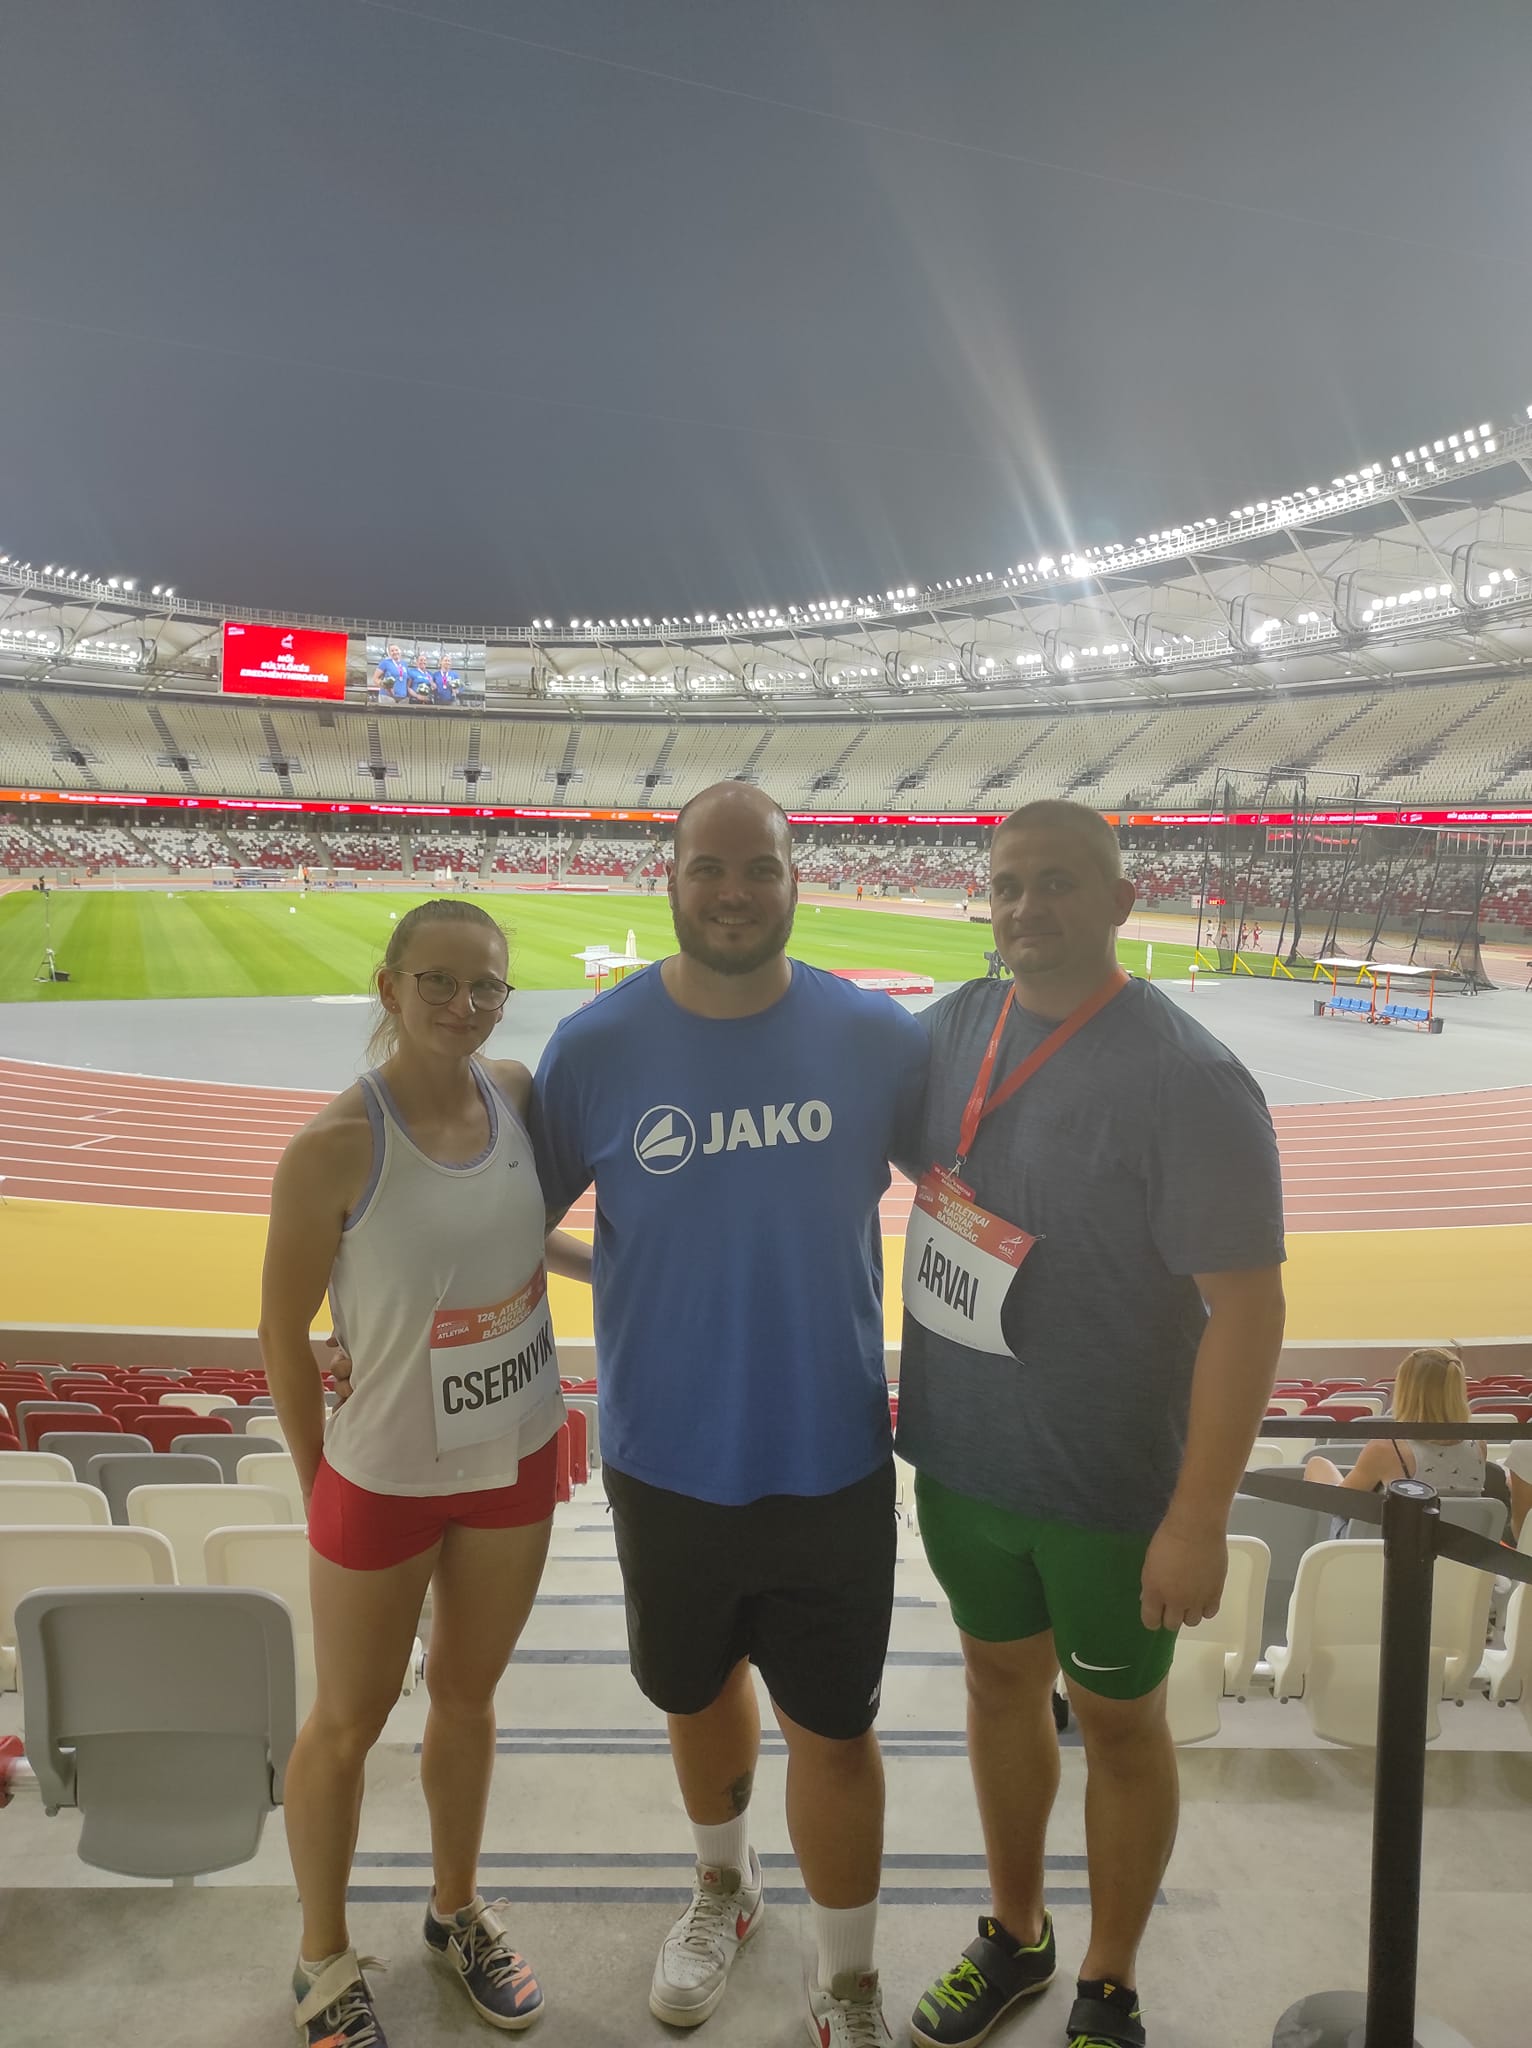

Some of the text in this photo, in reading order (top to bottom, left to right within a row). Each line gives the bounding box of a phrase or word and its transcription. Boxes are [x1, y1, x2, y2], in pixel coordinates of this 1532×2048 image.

[702, 1099, 833, 1155] JAKO
[942, 1205, 974, 1230] MAGYAR
[917, 1236, 979, 1321] ÁRVAI
[477, 1311, 498, 1324] 128.
[442, 1319, 552, 1415] CSERNYIK
